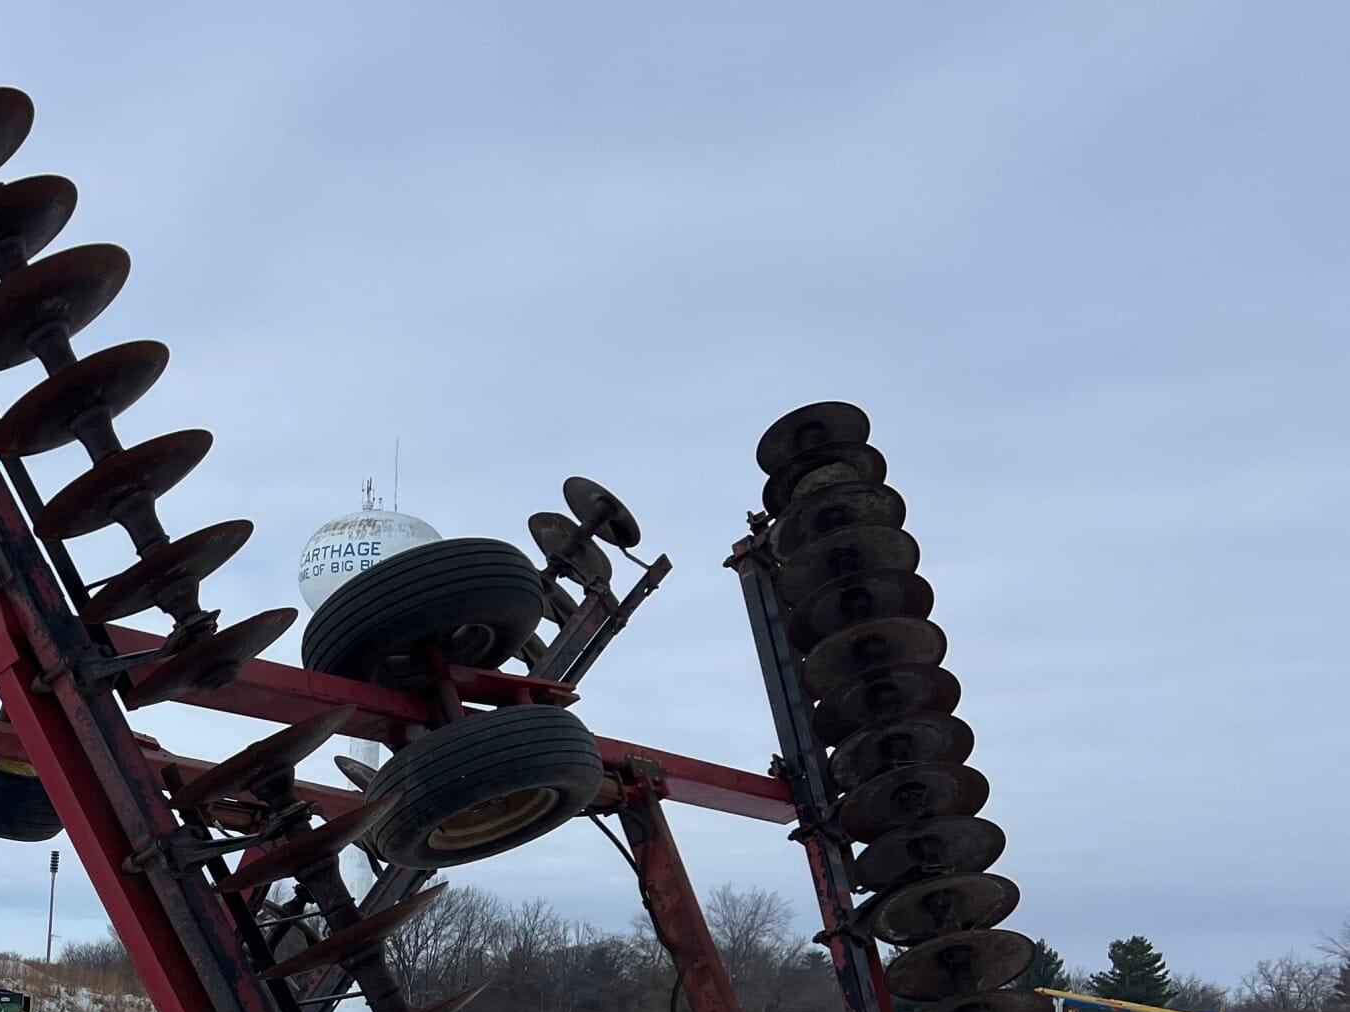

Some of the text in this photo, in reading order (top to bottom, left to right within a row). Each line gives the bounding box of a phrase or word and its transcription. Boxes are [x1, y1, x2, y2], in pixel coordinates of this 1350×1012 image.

[300, 541, 382, 567] CARTHAGE
[312, 563, 325, 577] OF
[330, 560, 354, 574] BIG
